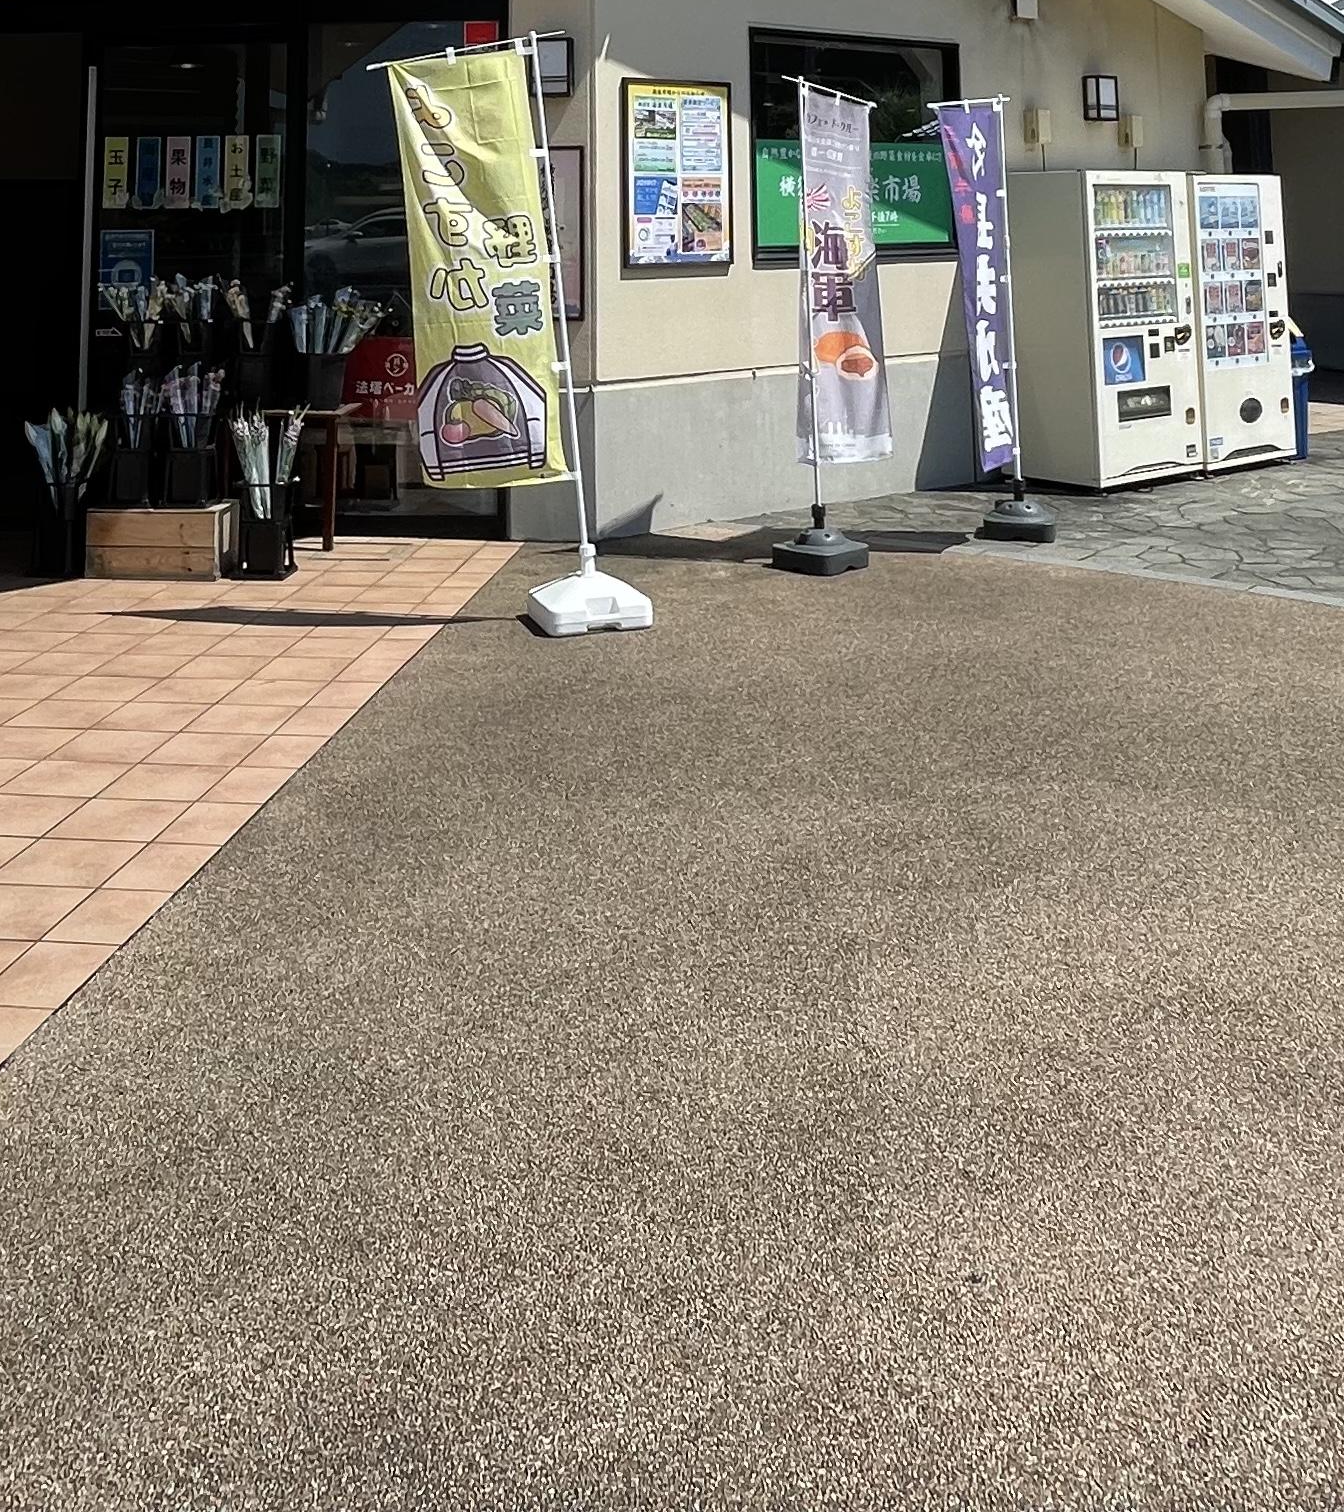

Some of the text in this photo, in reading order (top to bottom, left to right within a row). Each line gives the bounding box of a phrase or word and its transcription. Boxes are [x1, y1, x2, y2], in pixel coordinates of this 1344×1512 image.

[108, 149, 125, 196] 玉子
[170, 149, 187, 196] 果物
[811, 221, 856, 322] 海軍
